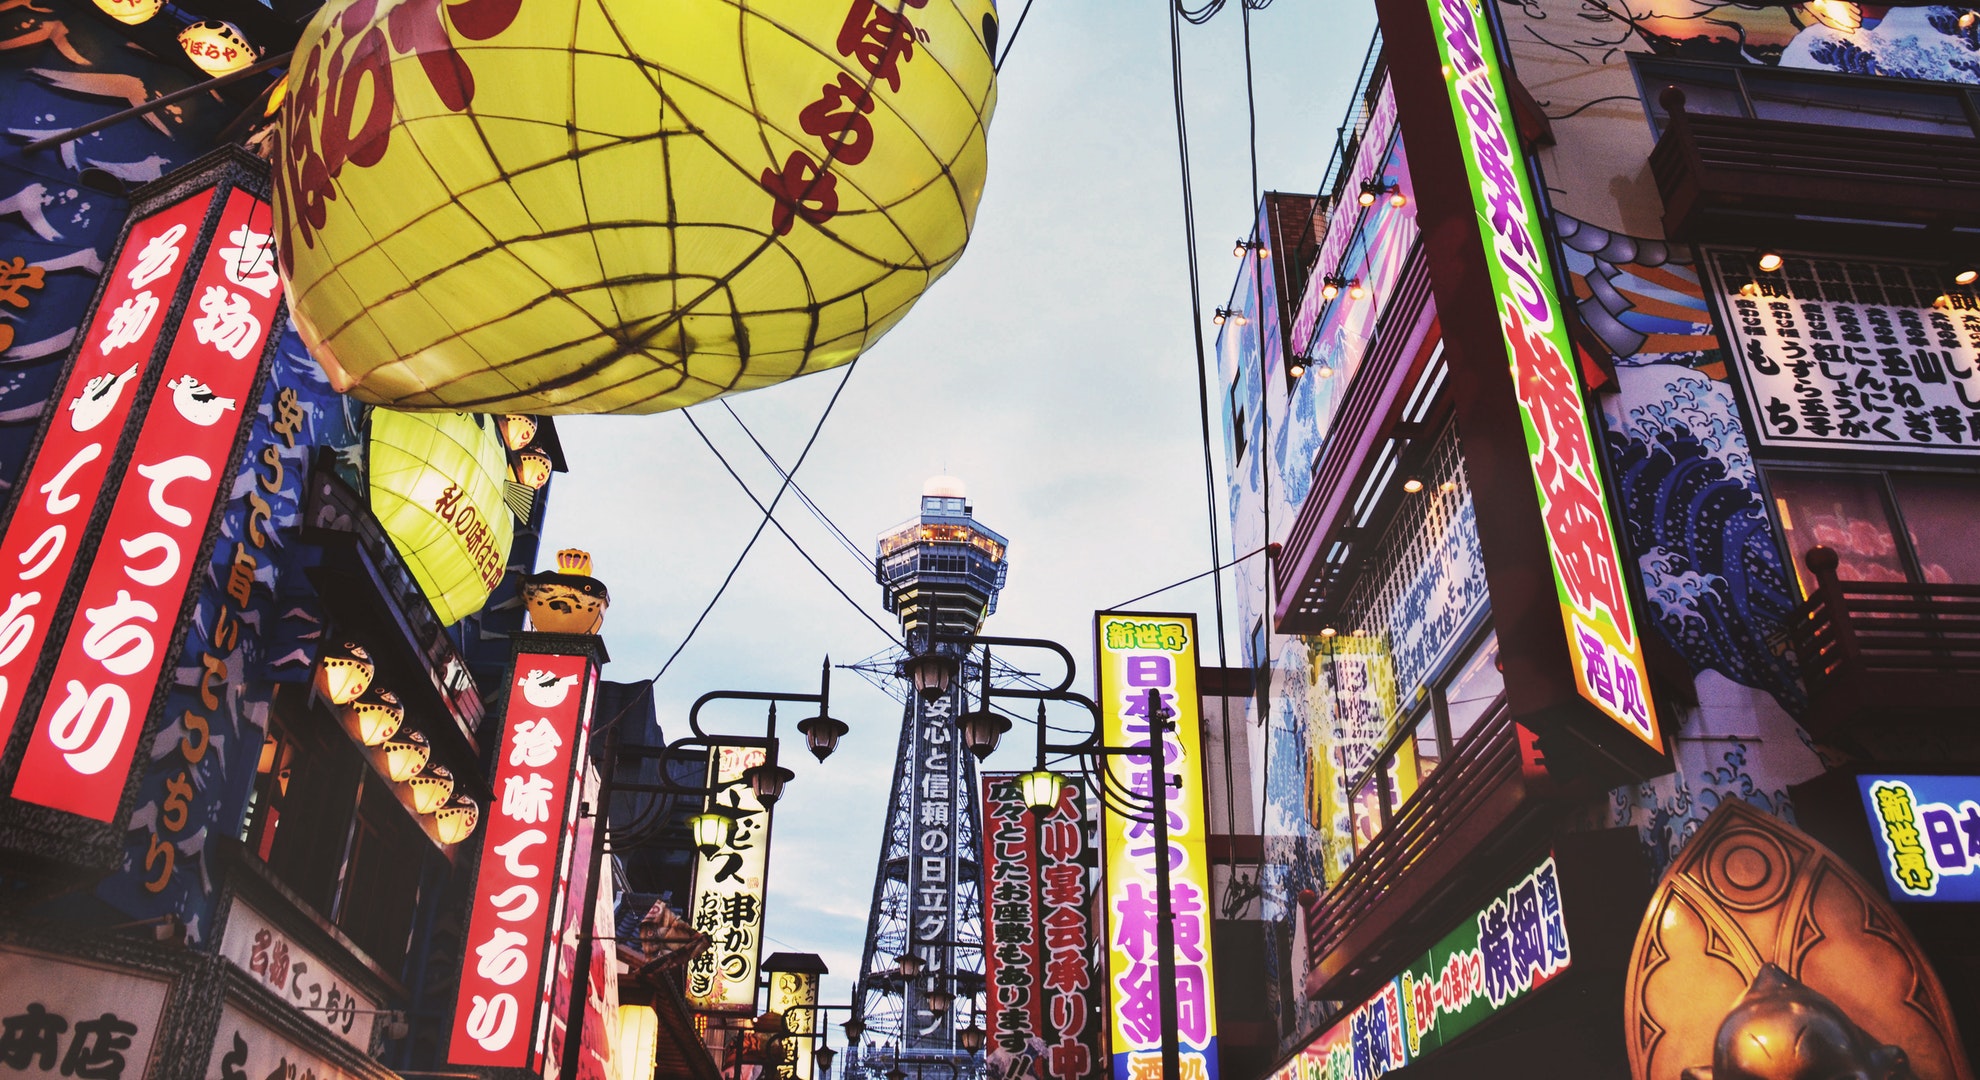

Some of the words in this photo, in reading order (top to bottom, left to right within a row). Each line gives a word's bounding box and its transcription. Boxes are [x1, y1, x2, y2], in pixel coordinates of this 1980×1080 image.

[761, 0, 930, 236] ぼらや
[100, 223, 187, 357] 名物
[193, 224, 280, 360] 名物
[1746, 338, 1799, 434] もち
[1781, 340, 1836, 436] うずら玉子
[1810, 342, 1870, 438] 紅しょうが
[1843, 345, 1900, 440] にんにく
[1876, 347, 1934, 442] 玉ねぎ
[1910, 349, 1967, 443] 山芋
[1504, 303, 1632, 646] 横綱
[1576, 624, 1649, 731] 酒処
[0, 442, 102, 715] てっち
[48, 455, 212, 775] てっちり
[1107, 624, 1185, 649] 新世界
[1124, 657, 1183, 875] 日本一の串かつ
[465, 716, 562, 1053] 珍味てっちり
[1875, 786, 1933, 890] 新世界
[690, 890, 720, 994] お好焼き
[720, 892, 757, 979] 串かつ
[1118, 884, 1206, 1043] 横綱
[1414, 953, 1481, 1032] 日本一の串かつ
[1480, 879, 1547, 1003] 横綱
[1536, 863, 1567, 967] 酒処
[1386, 987, 1403, 1064] 酒処
